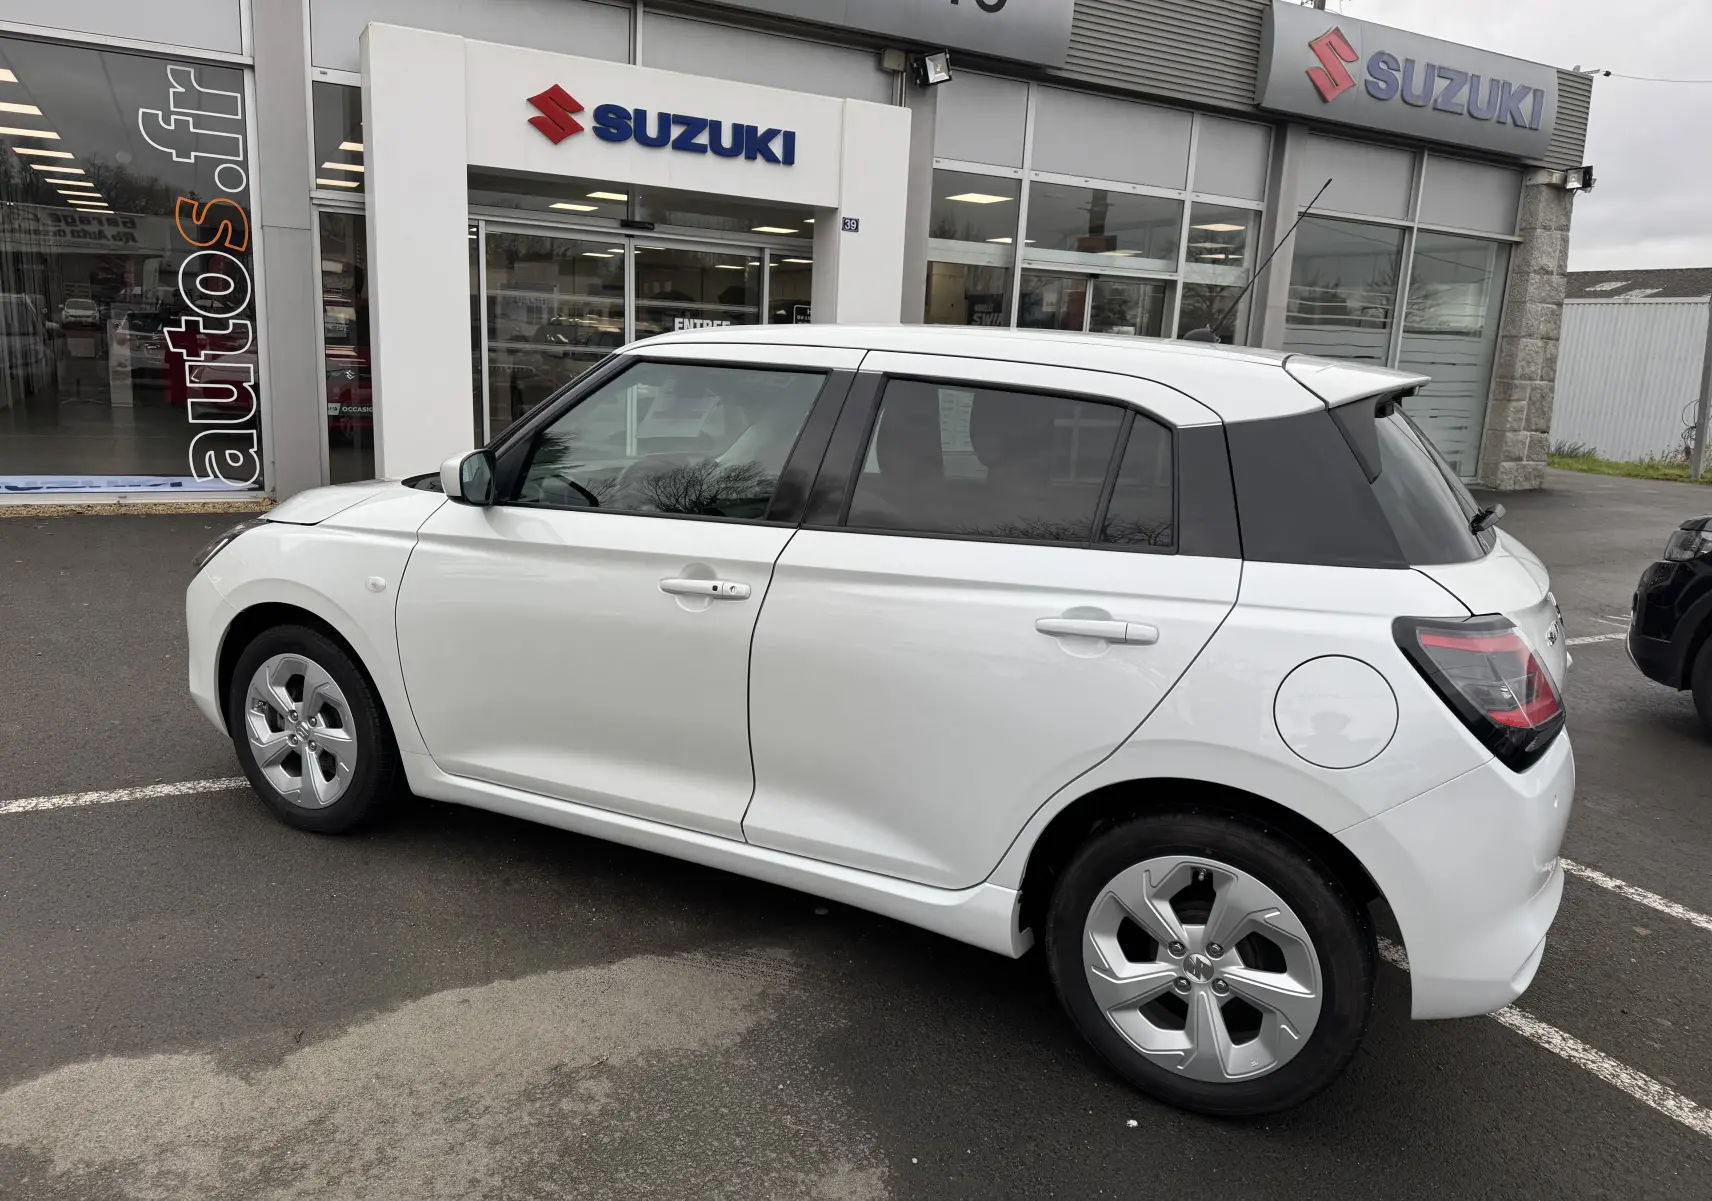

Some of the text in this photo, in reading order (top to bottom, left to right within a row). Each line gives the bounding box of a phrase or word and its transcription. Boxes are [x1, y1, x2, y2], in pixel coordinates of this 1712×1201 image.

[1364, 50, 1545, 130] SUZUKI
[592, 103, 796, 166] SUZUKI
[844, 219, 857, 230] 39
[139, 65, 260, 487] autos.fr
